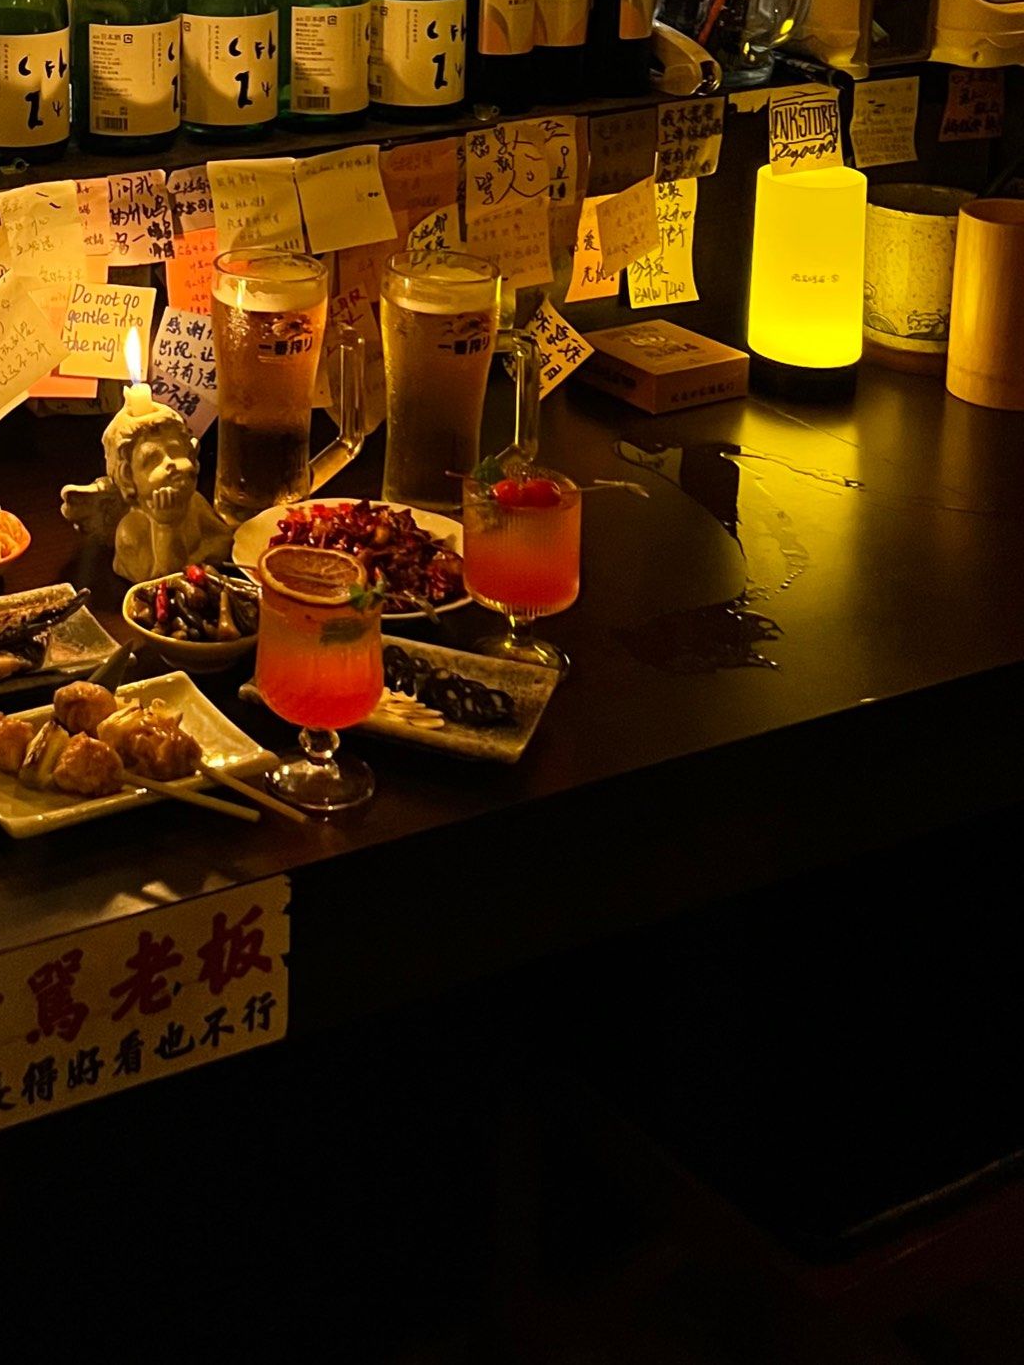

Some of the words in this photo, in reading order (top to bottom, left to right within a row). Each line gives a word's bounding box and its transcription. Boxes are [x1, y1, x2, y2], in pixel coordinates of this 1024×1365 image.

[71, 284, 93, 305] Do
[95, 291, 121, 307] not
[122, 294, 140, 315] go
[64, 307, 111, 331] gentle
[113, 312, 144, 328] into
[63, 334, 90, 354] the
